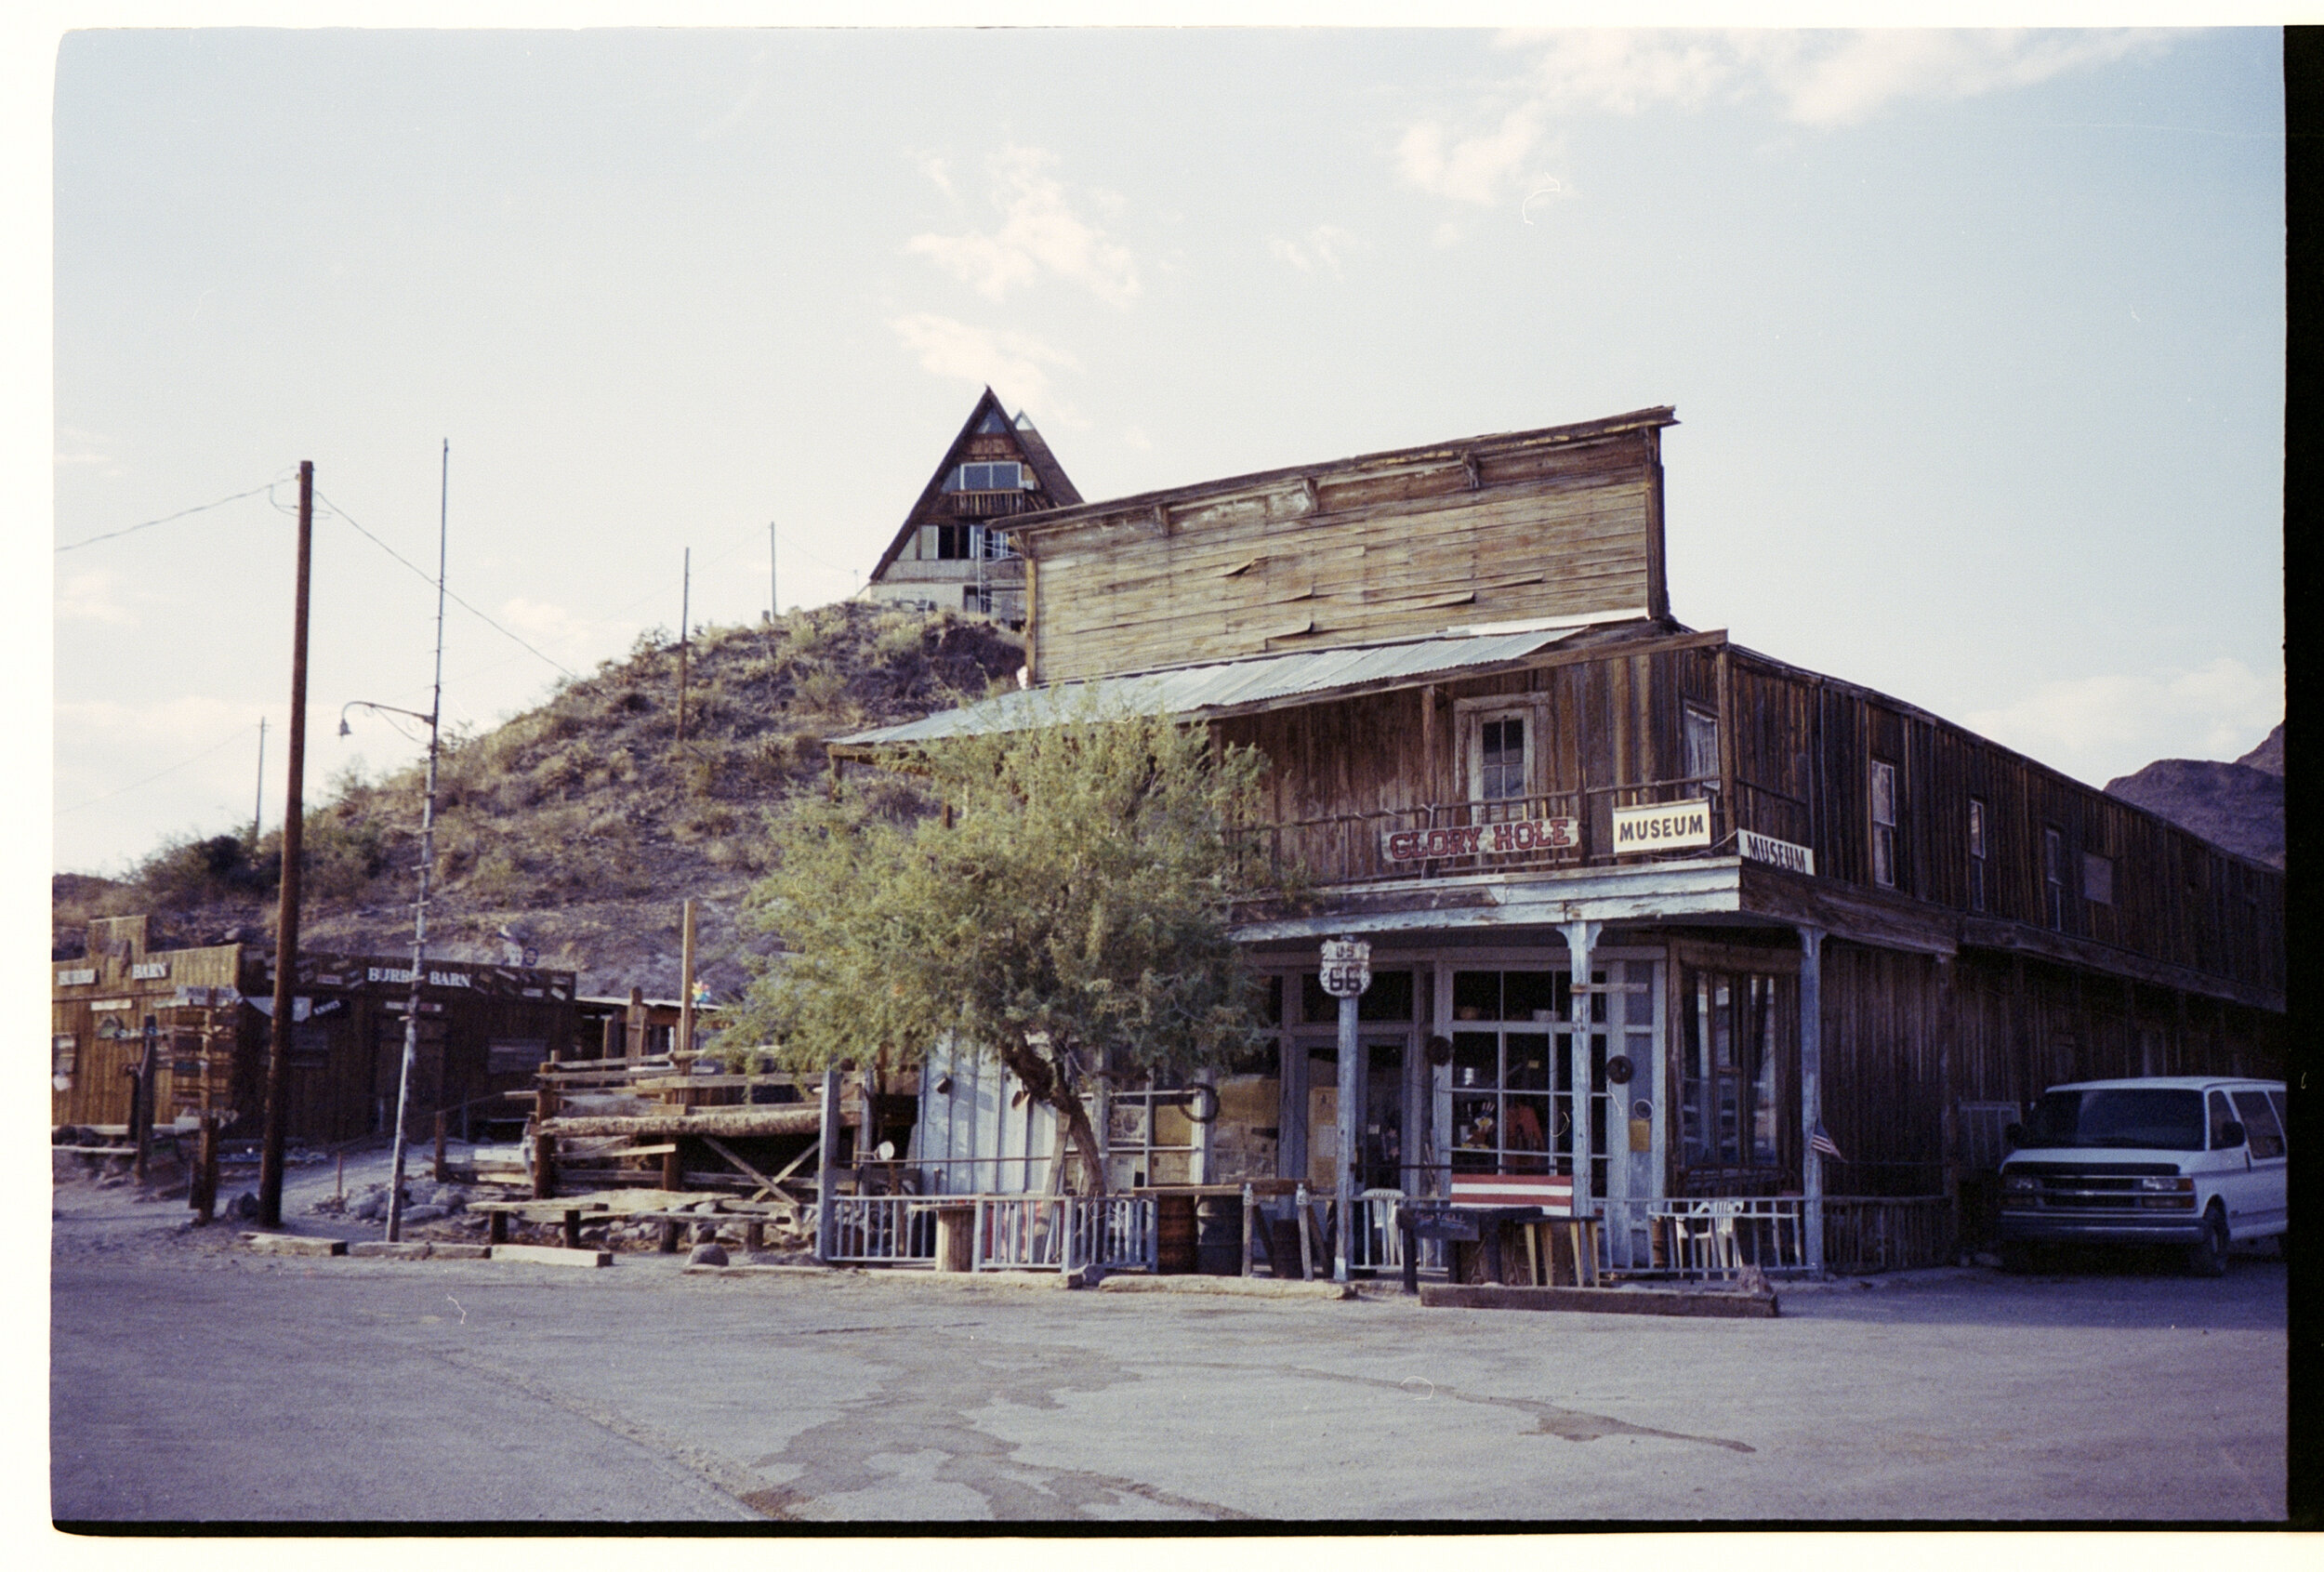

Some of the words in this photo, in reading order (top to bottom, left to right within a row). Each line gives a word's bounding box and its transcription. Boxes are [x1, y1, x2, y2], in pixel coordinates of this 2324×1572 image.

[1389, 826, 1483, 861] GLORY
[1492, 818, 1571, 851] HOLE
[1618, 813, 1705, 842] MUSEUM
[1746, 833, 1807, 875] MUSEUM
[1336, 945, 1354, 958] US
[429, 970, 472, 988] BARN
[1329, 964, 1362, 992] 66
